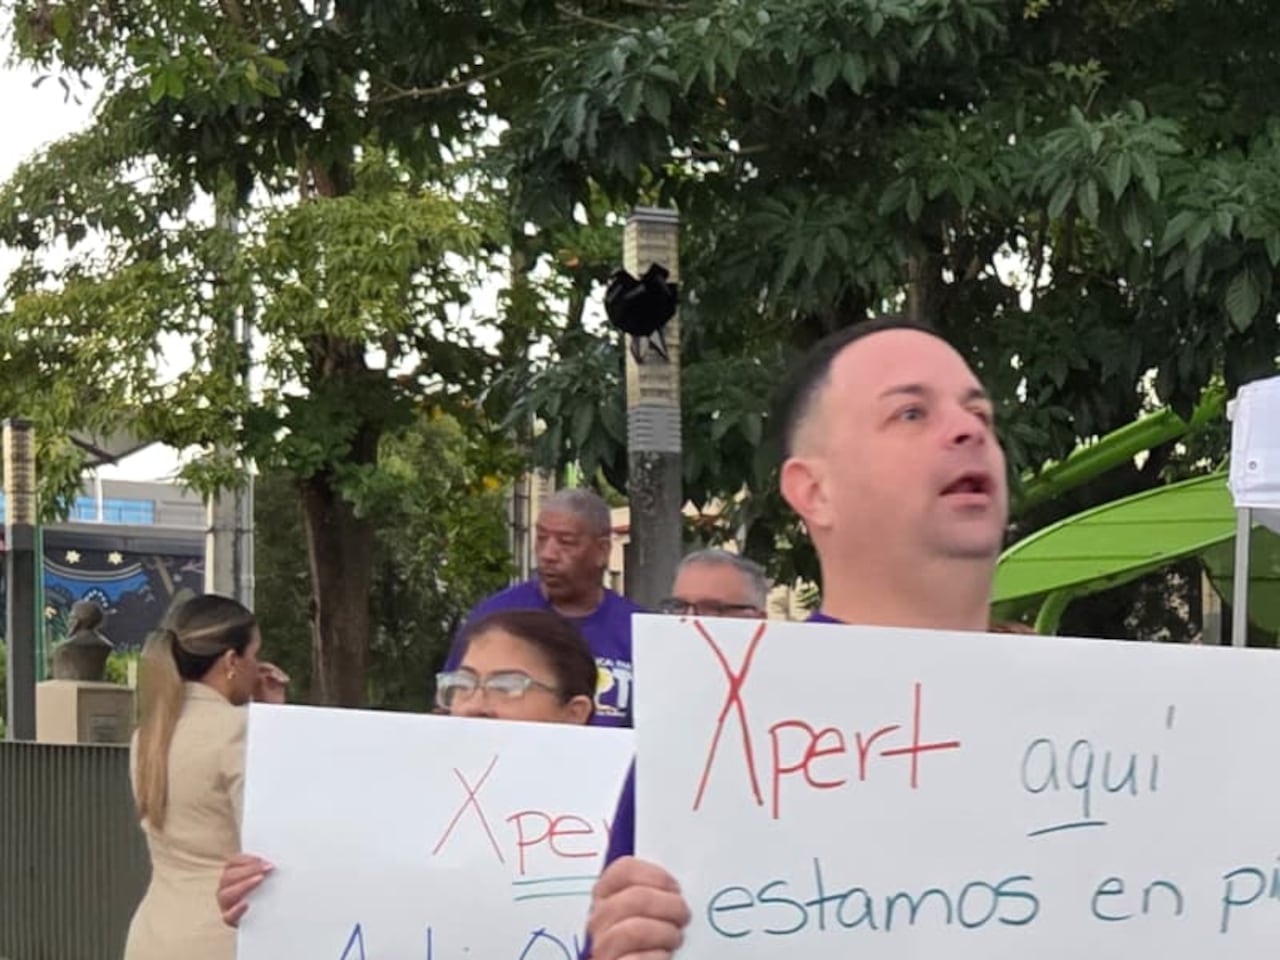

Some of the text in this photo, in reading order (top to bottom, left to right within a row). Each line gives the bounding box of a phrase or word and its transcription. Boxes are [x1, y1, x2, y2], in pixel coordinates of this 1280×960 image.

[692, 621, 962, 820] Xpert
[706, 856, 1041, 940] estamos
[1090, 876, 1184, 923] en
